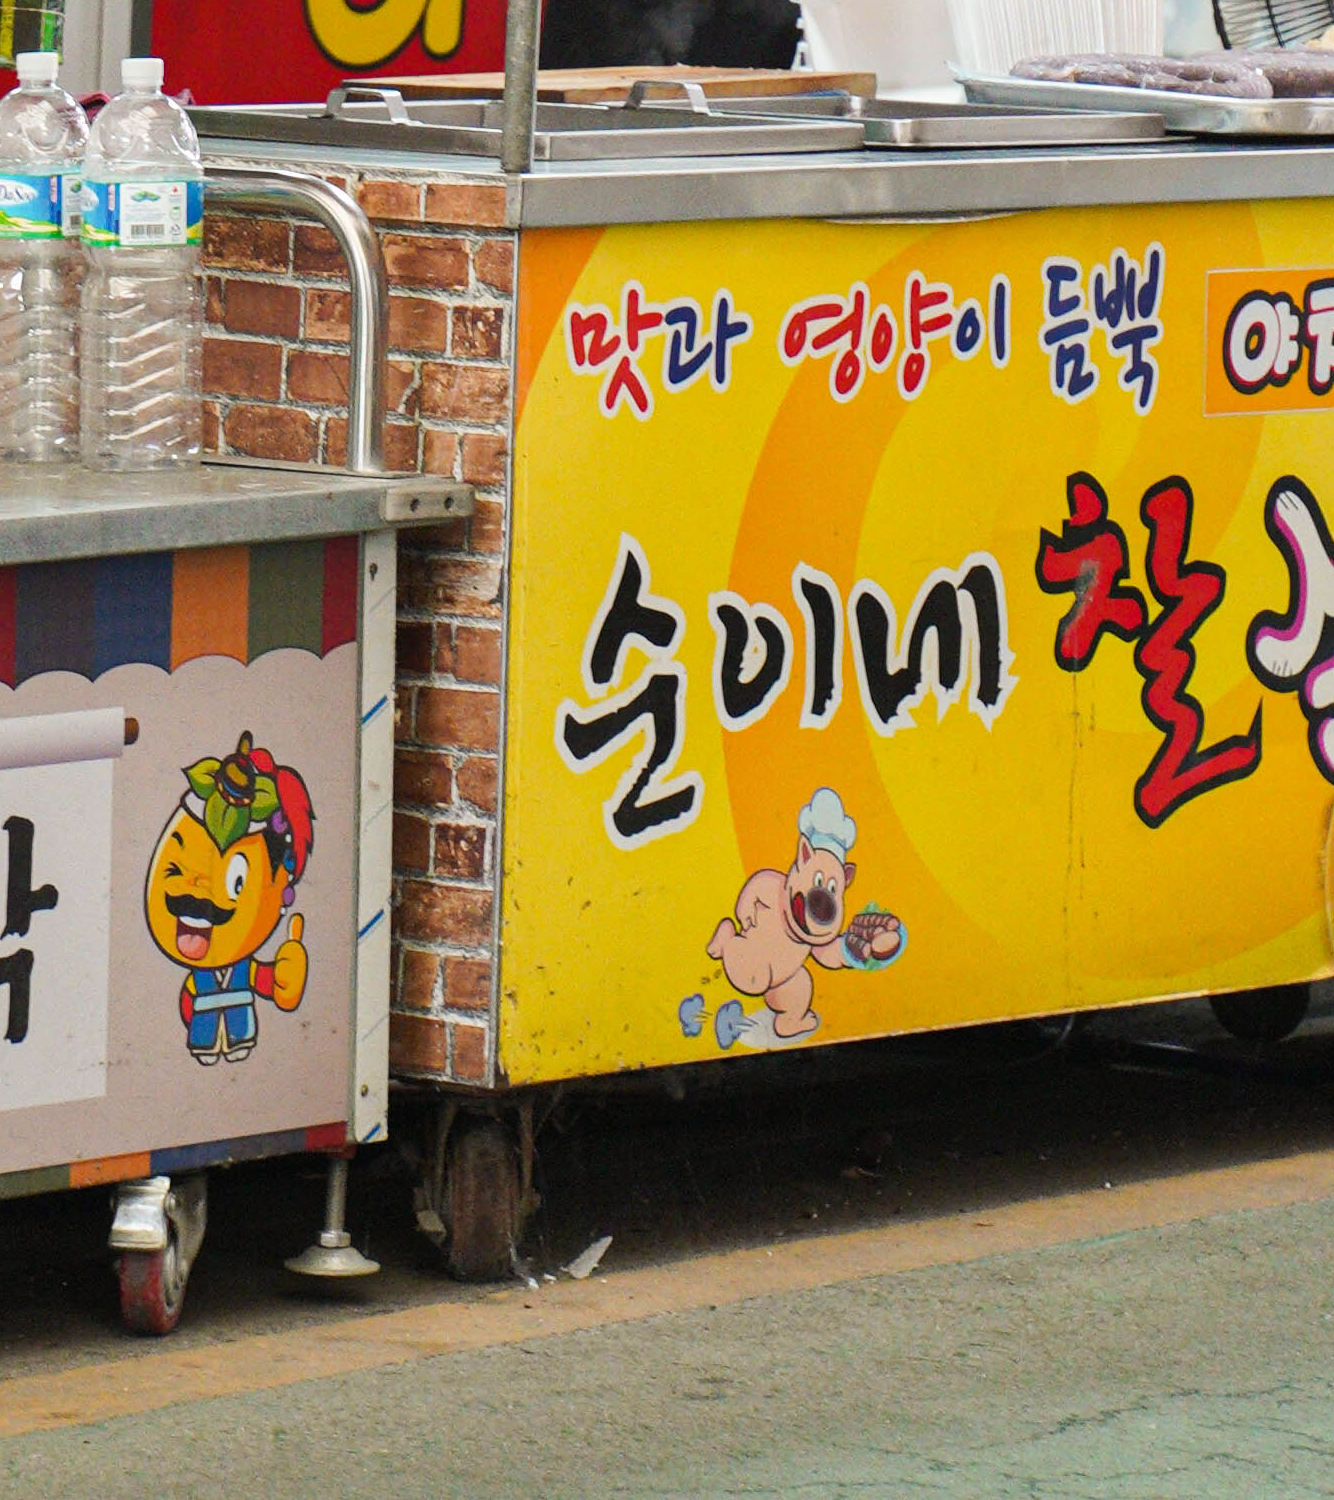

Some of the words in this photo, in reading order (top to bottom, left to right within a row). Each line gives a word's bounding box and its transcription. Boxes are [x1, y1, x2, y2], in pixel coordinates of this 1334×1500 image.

[569, 284, 750, 416] 맛과
[781, 274, 1008, 399] 영양이
[1041, 244, 1164, 413] 듬뿍
[557, 533, 1015, 848] 순이네
